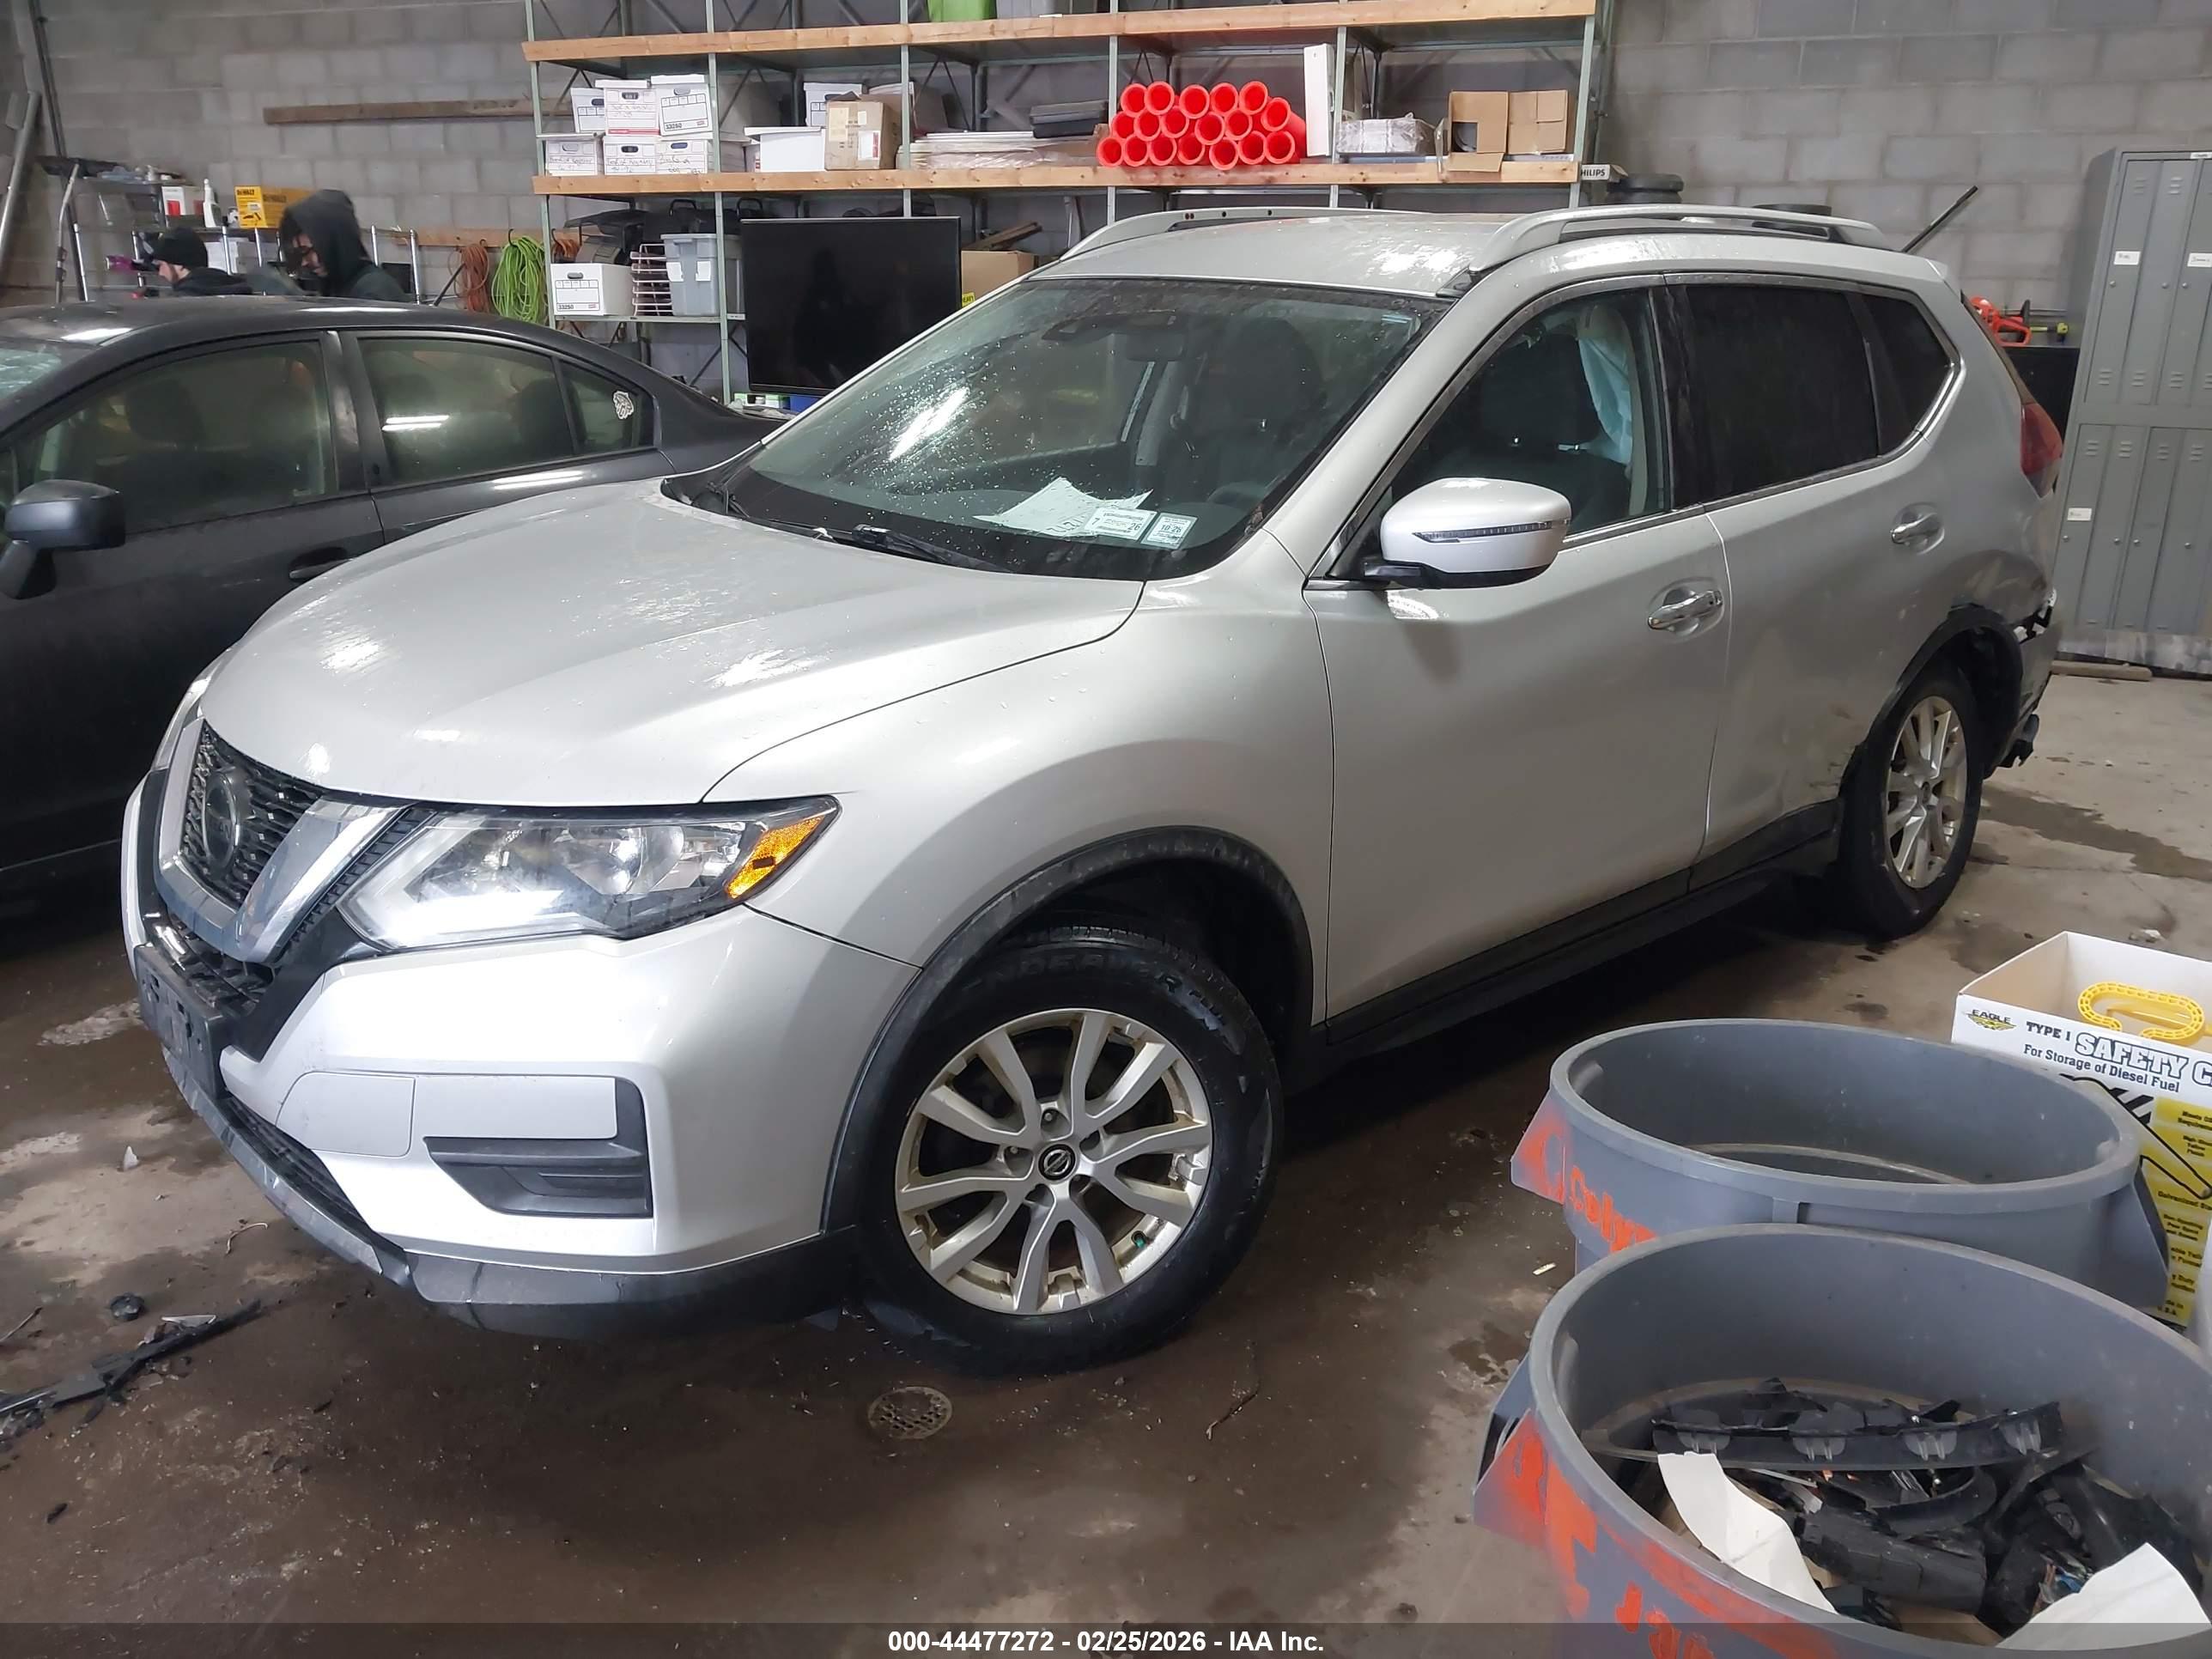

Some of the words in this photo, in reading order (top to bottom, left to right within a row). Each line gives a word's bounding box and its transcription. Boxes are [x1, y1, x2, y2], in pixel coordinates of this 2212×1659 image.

[1581, 168, 1606, 177] HILIPS
[1972, 1009, 2011, 1023] EAGLE
[2023, 1043, 2043, 1058] For
[2045, 1049, 2092, 1071] Storage
[2094, 1063, 2107, 1074] of
[2109, 1066, 2148, 1085] Diesel
[2151, 1076, 2180, 1093] Fuel
[2026, 1020, 2063, 1039] TYPE
[2075, 1032, 2189, 1079] SAFETY
[2191, 1060, 2212, 1088] C
